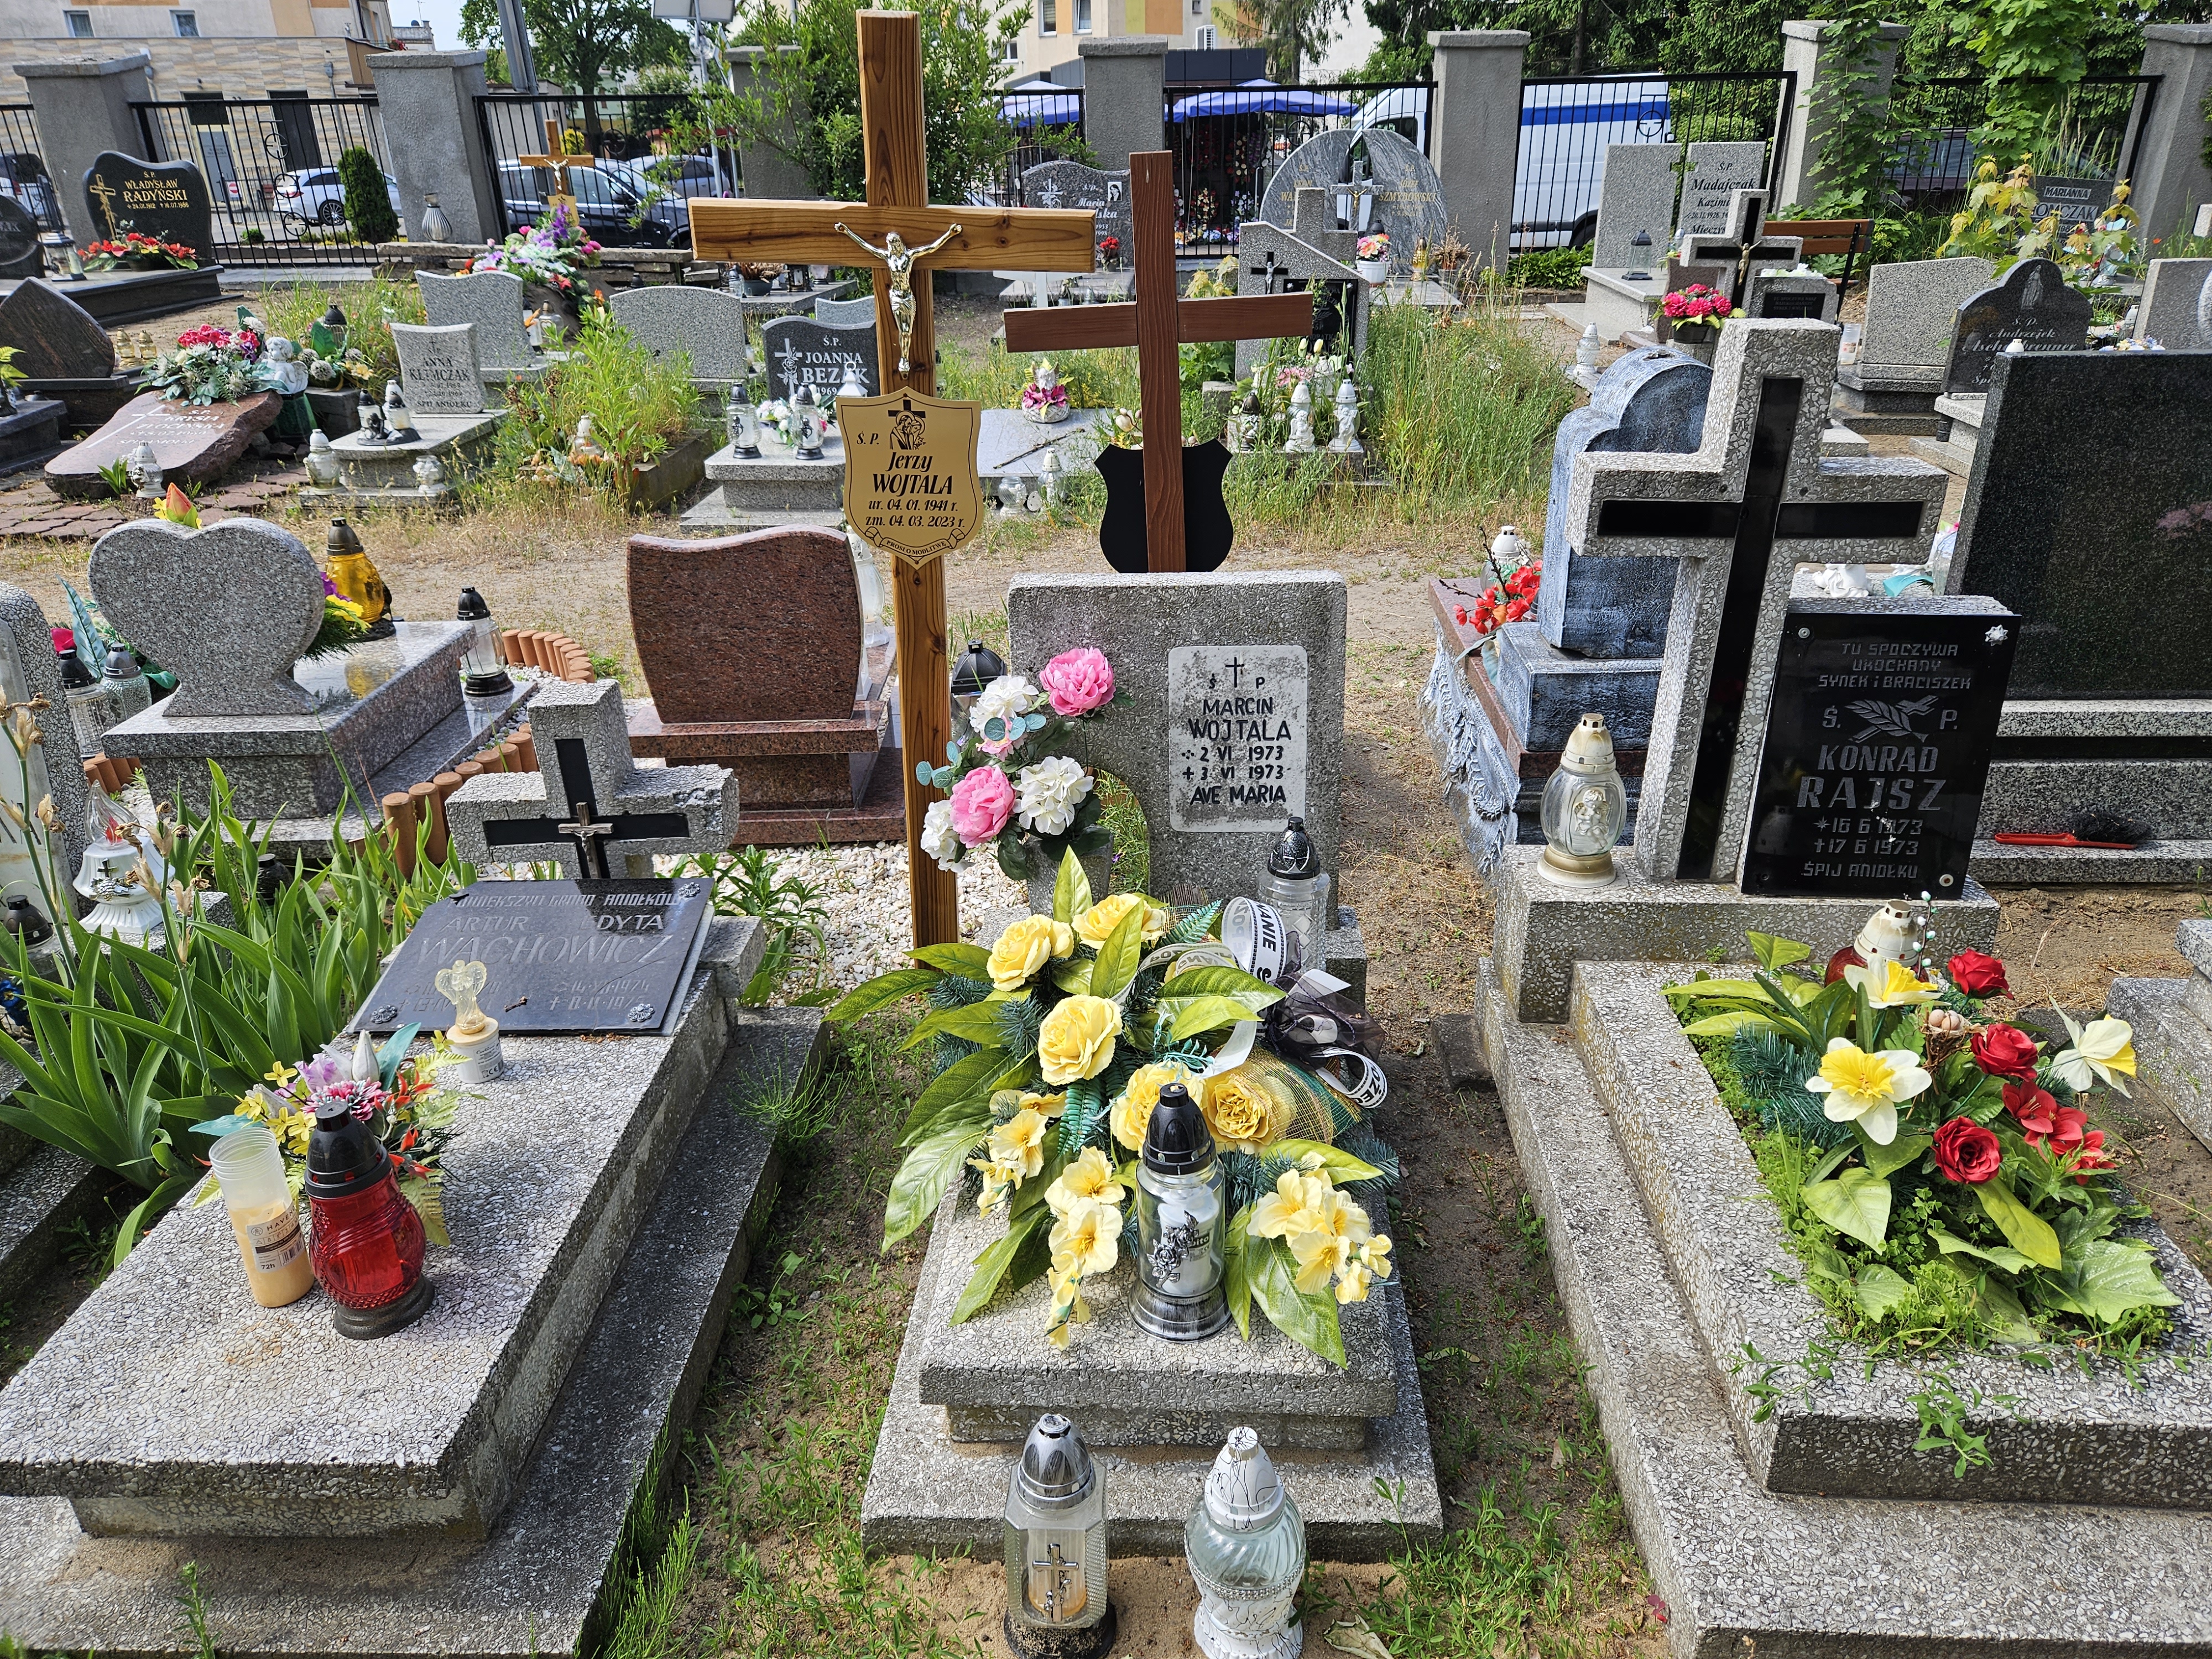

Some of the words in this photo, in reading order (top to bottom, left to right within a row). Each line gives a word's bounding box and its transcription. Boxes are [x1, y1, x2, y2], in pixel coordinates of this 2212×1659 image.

[124, 179, 178, 189] WŁADYSŁAW
[1691, 178, 1756, 192] Madajczak
[123, 189, 188, 202] RADYŃSKI
[2045, 186, 2089, 199] MARIANNA
[1697, 197, 1731, 207] Kazimi
[2033, 203, 2098, 220] OMCZAK
[1691, 225, 1726, 234] Mieczys
[823, 335, 842, 346] Ś.P.
[1989, 328, 2056, 340] Andrzejek
[805, 352, 863, 364] JOANNA
[885, 452, 933, 472] Jerzy
[873, 473, 953, 494] WOJTALA
[868, 500, 883, 510] ur.
[887, 499, 902, 510] 04.
[906, 499, 920, 510] 01.
[925, 499, 949, 512] 1941
[951, 502, 958, 512] r.
[865, 517, 885, 526] zm.
[889, 515, 905, 526] 04.
[908, 515, 924, 526] 03.
[928, 516, 954, 528] 2023
[958, 518, 965, 528] r.
[886, 540, 905, 551] PROSI
[912, 540, 947, 555] MODLITWĘ
[1841, 644, 1862, 656] TU
[1869, 644, 1958, 656] SPOCZYWA
[1853, 659, 1942, 672] UKOCHANY
[1818, 675, 1870, 687] SYNEK
[1882, 676, 1971, 689] BRACISZEK
[1203, 697, 1273, 716] MARCIN
[1822, 706, 1841, 728] Ś.
[1939, 710, 1958, 730] P.
[1189, 718, 1291, 741] WOJTALA
[1200, 747, 1209, 762] 2
[1217, 747, 1232, 761] VI
[1249, 745, 1284, 760] 1973
[1817, 745, 1939, 772] KONRAD
[1201, 766, 1208, 780] 3
[1221, 766, 1235, 779] VI
[1249, 764, 1284, 779] 1973
[1190, 785, 1222, 805] AVE
[1229, 785, 1286, 804] MARIA
[1797, 776, 1947, 811] RAJSZ
[1833, 818, 1850, 833] 16
[1858, 818, 1870, 833] 6
[1828, 838, 1844, 853] 17
[1854, 839, 1866, 854] 6
[1874, 839, 1918, 855] 1973
[1803, 861, 1842, 877] ŚPIJ
[1848, 864, 1918, 878] ANIOŁKU
[440, 916, 529, 932] ARTUR
[578, 914, 665, 931] EDYTA
[418, 935, 674, 965] WACHOWICZ
